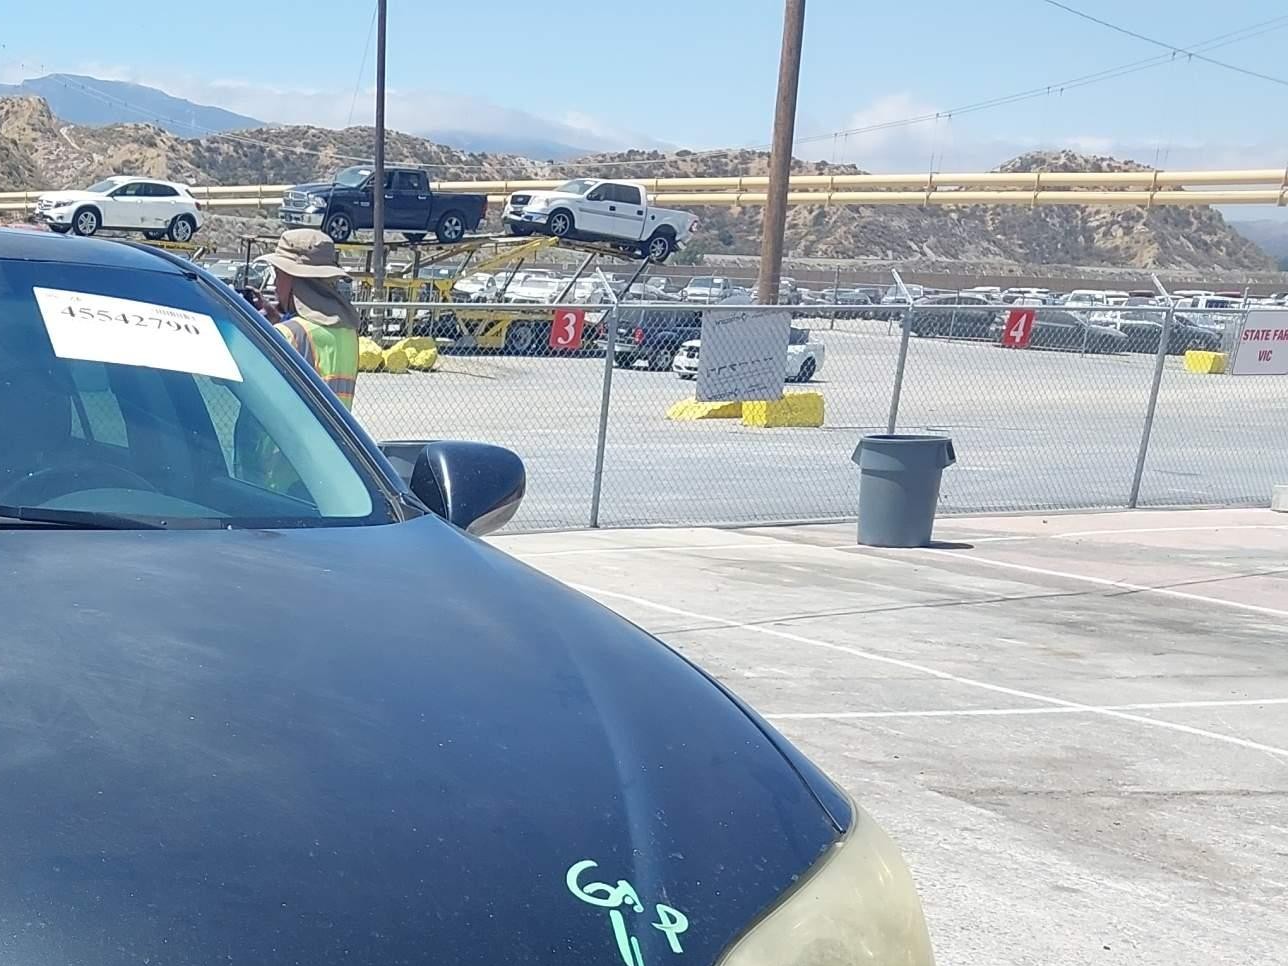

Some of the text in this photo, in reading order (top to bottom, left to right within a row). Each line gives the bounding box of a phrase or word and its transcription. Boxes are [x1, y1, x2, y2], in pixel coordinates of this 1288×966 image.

[60, 305, 200, 336] 45542790
[557, 312, 577, 345] 3
[1009, 313, 1028, 343] 4
[1242, 329, 1272, 341] STATE
[1257, 350, 1273, 362] VIC
